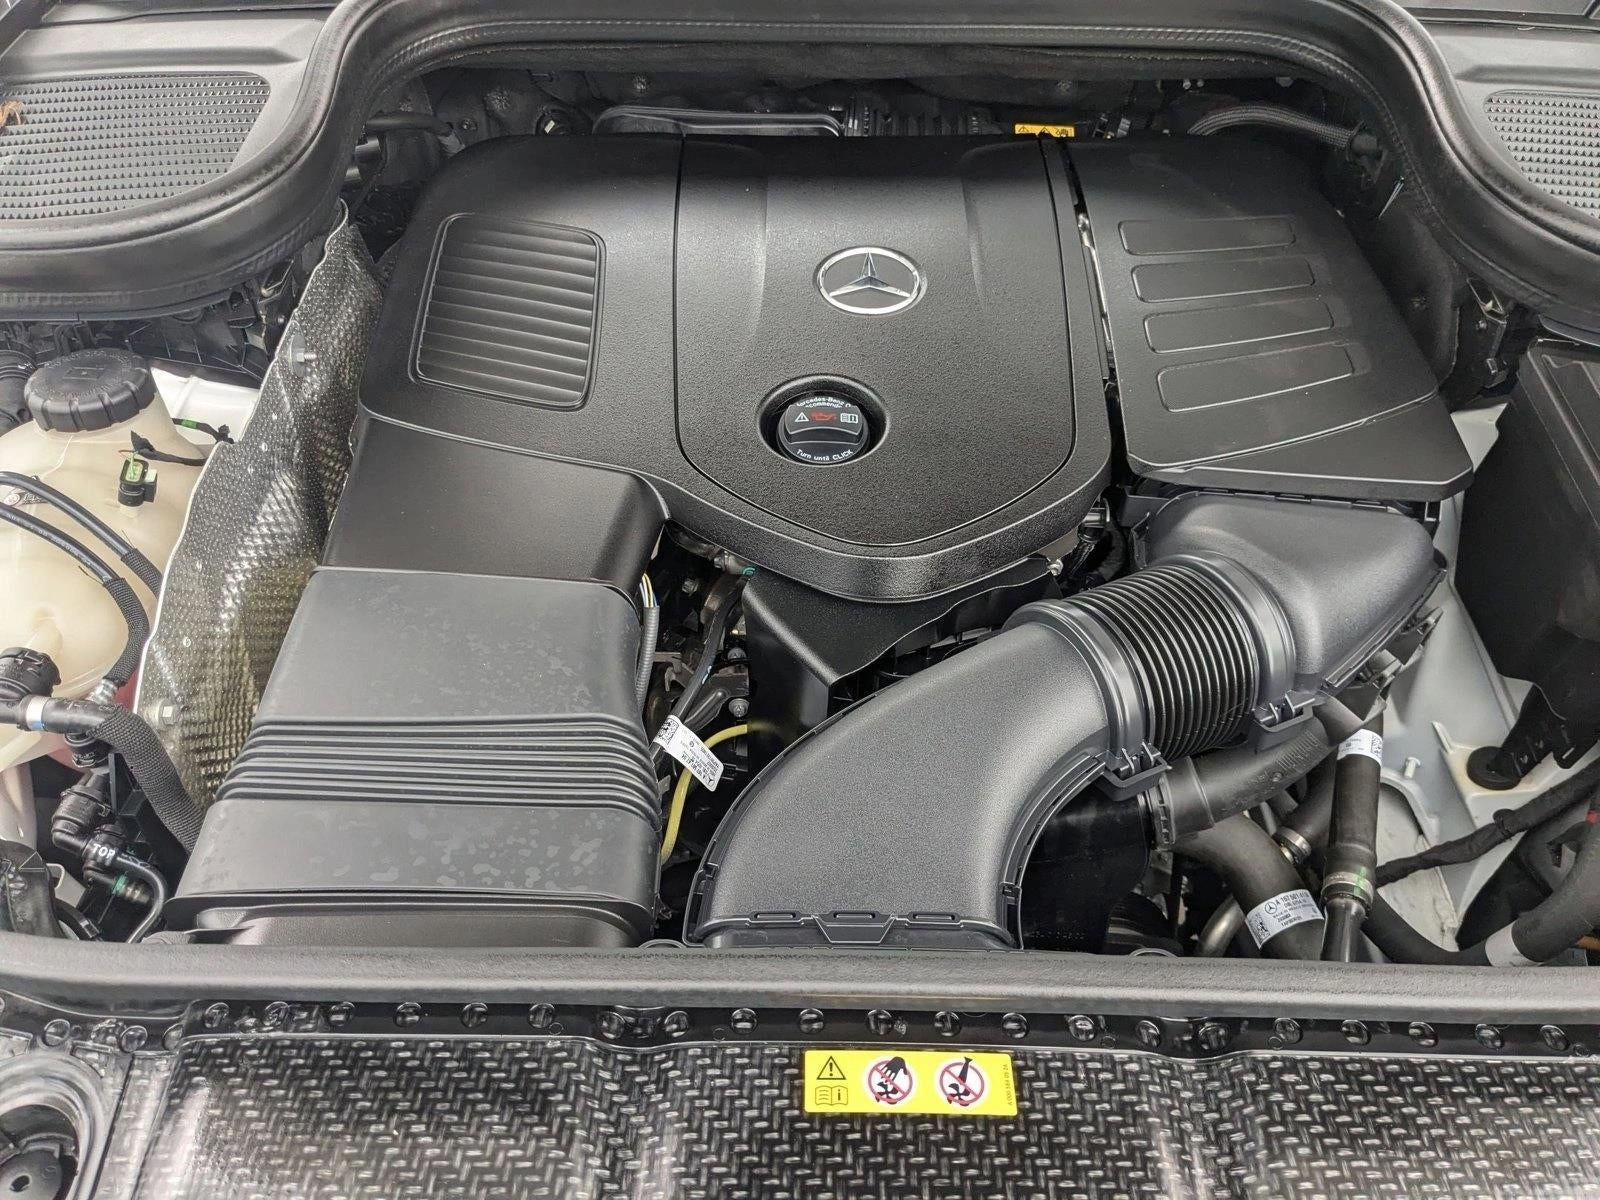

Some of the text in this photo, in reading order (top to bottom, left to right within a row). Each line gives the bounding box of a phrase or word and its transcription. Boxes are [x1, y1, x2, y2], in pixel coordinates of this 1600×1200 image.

[797, 449, 811, 459] Turn
[832, 449, 853, 460] CLICK
[93, 843, 115, 859] TOP
